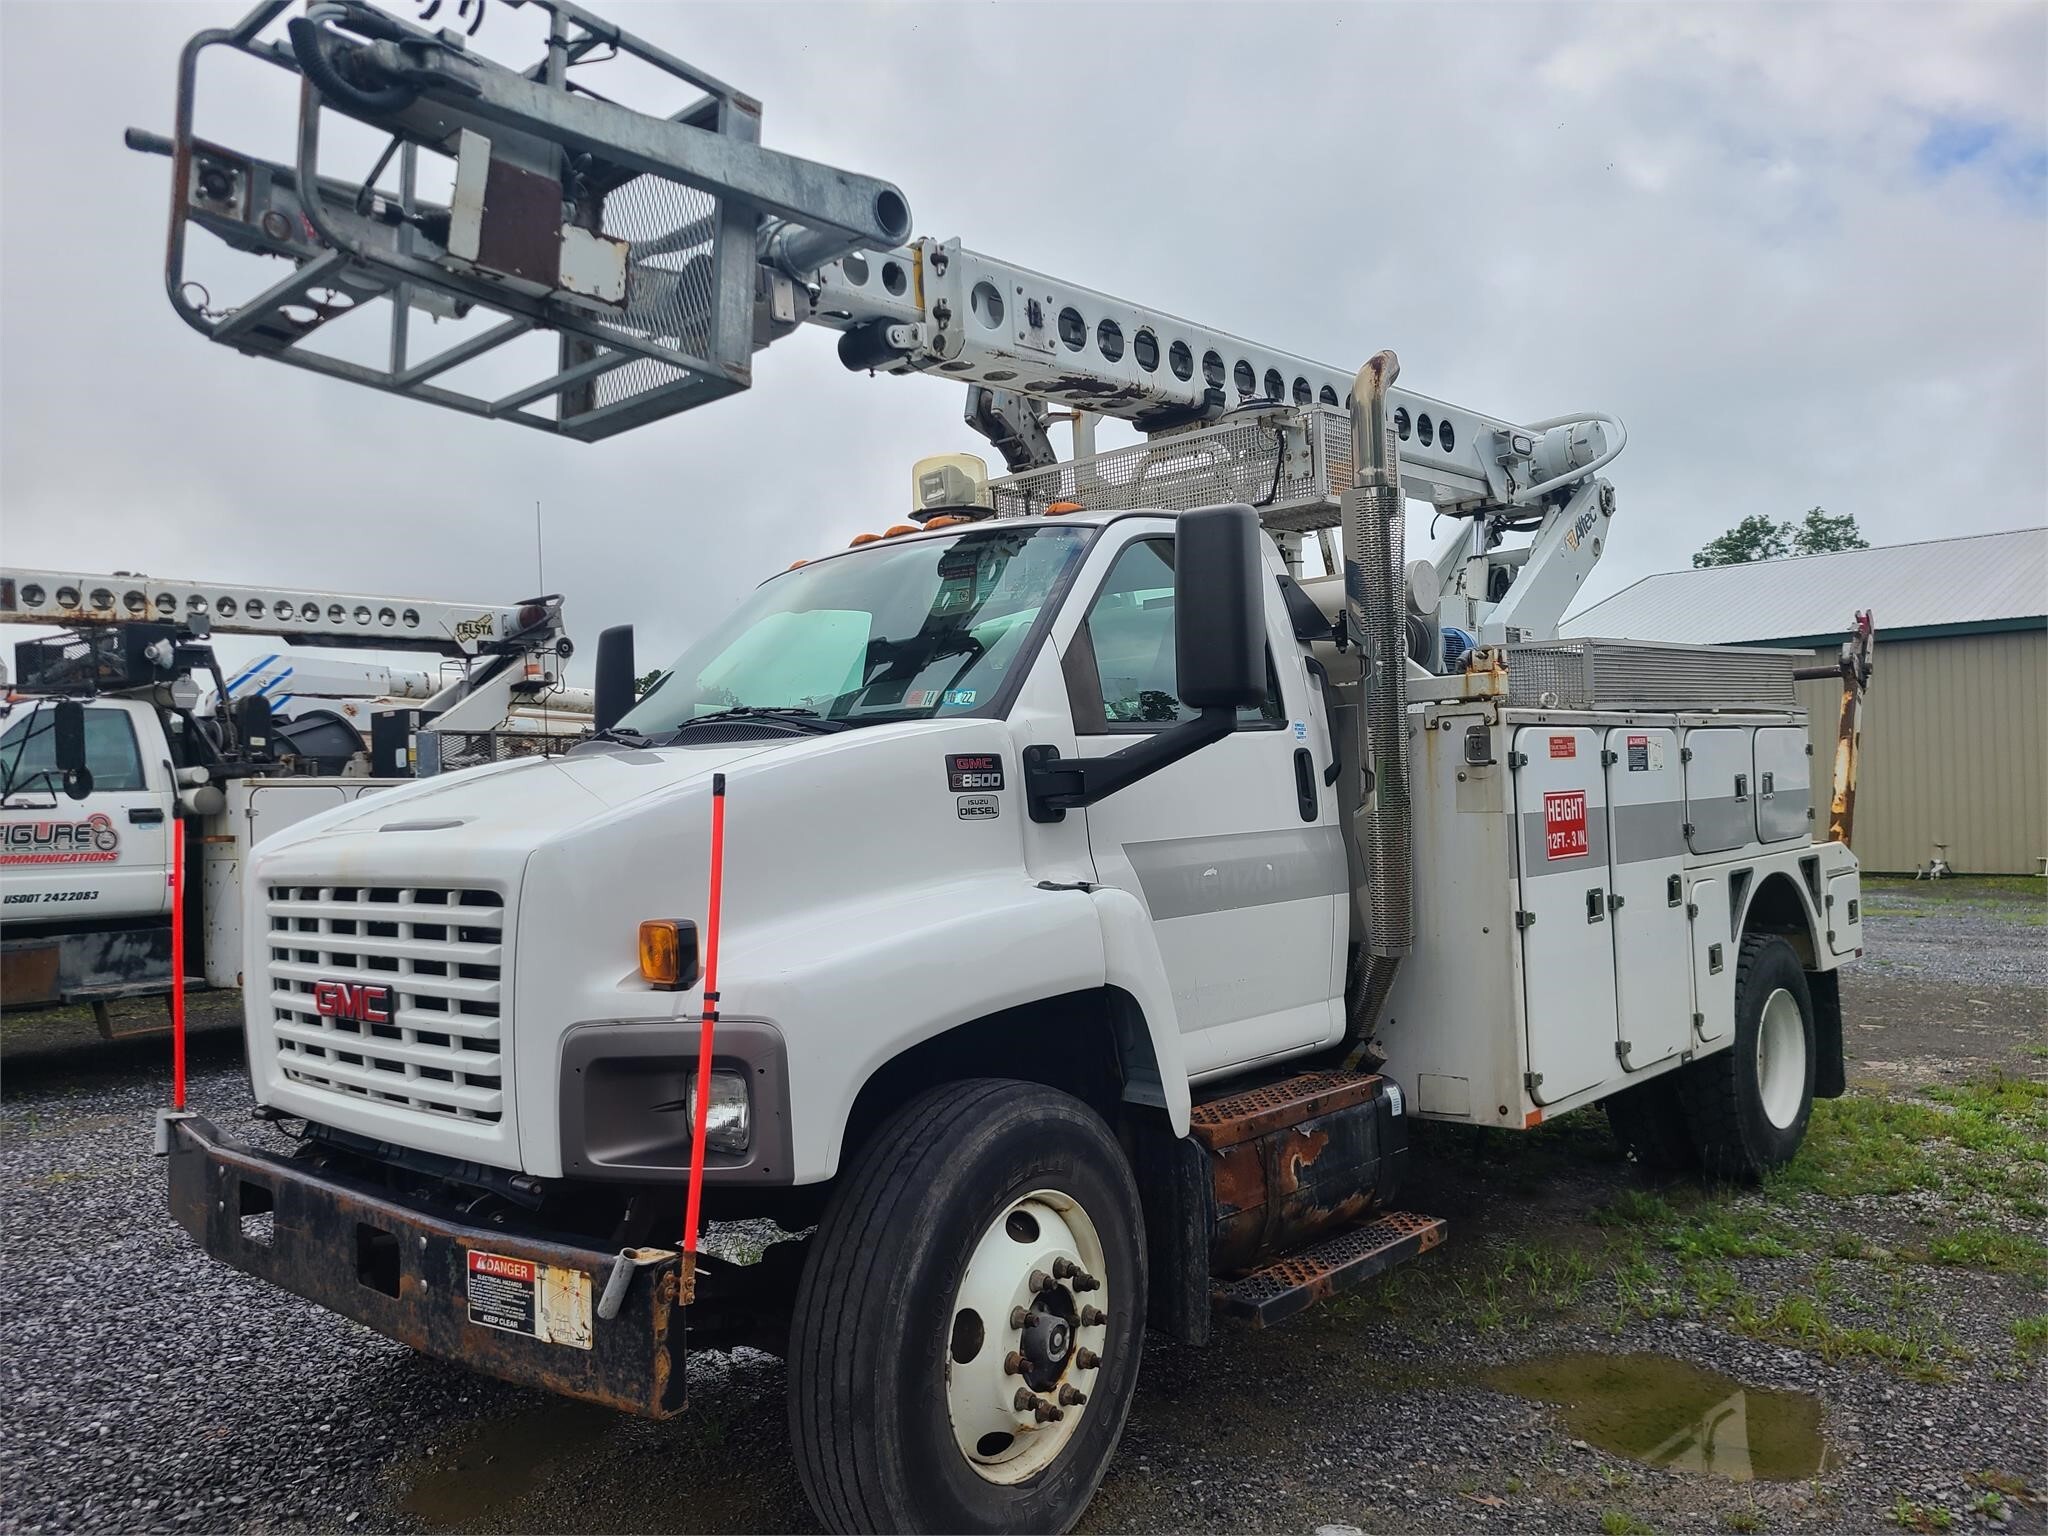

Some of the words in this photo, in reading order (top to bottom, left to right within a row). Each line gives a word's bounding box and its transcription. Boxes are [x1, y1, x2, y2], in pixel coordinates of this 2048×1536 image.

[1575, 505, 1597, 546] Altec
[956, 757, 993, 769] GMC
[952, 773, 1001, 788] C8500
[960, 806, 998, 816] DIESEL
[1547, 797, 1583, 822] HEIGHT
[0, 824, 92, 844] IGURE
[1571, 830, 1577, 847] 3
[0, 852, 118, 865] OMMUNICATIONS
[3, 894, 42, 904] USDOT
[43, 890, 100, 903] 2422083
[315, 981, 390, 1022] GMC
[486, 1258, 528, 1279] DANGER
[483, 1314, 499, 1323] KEEP
[499, 1317, 519, 1329] CLEAR
